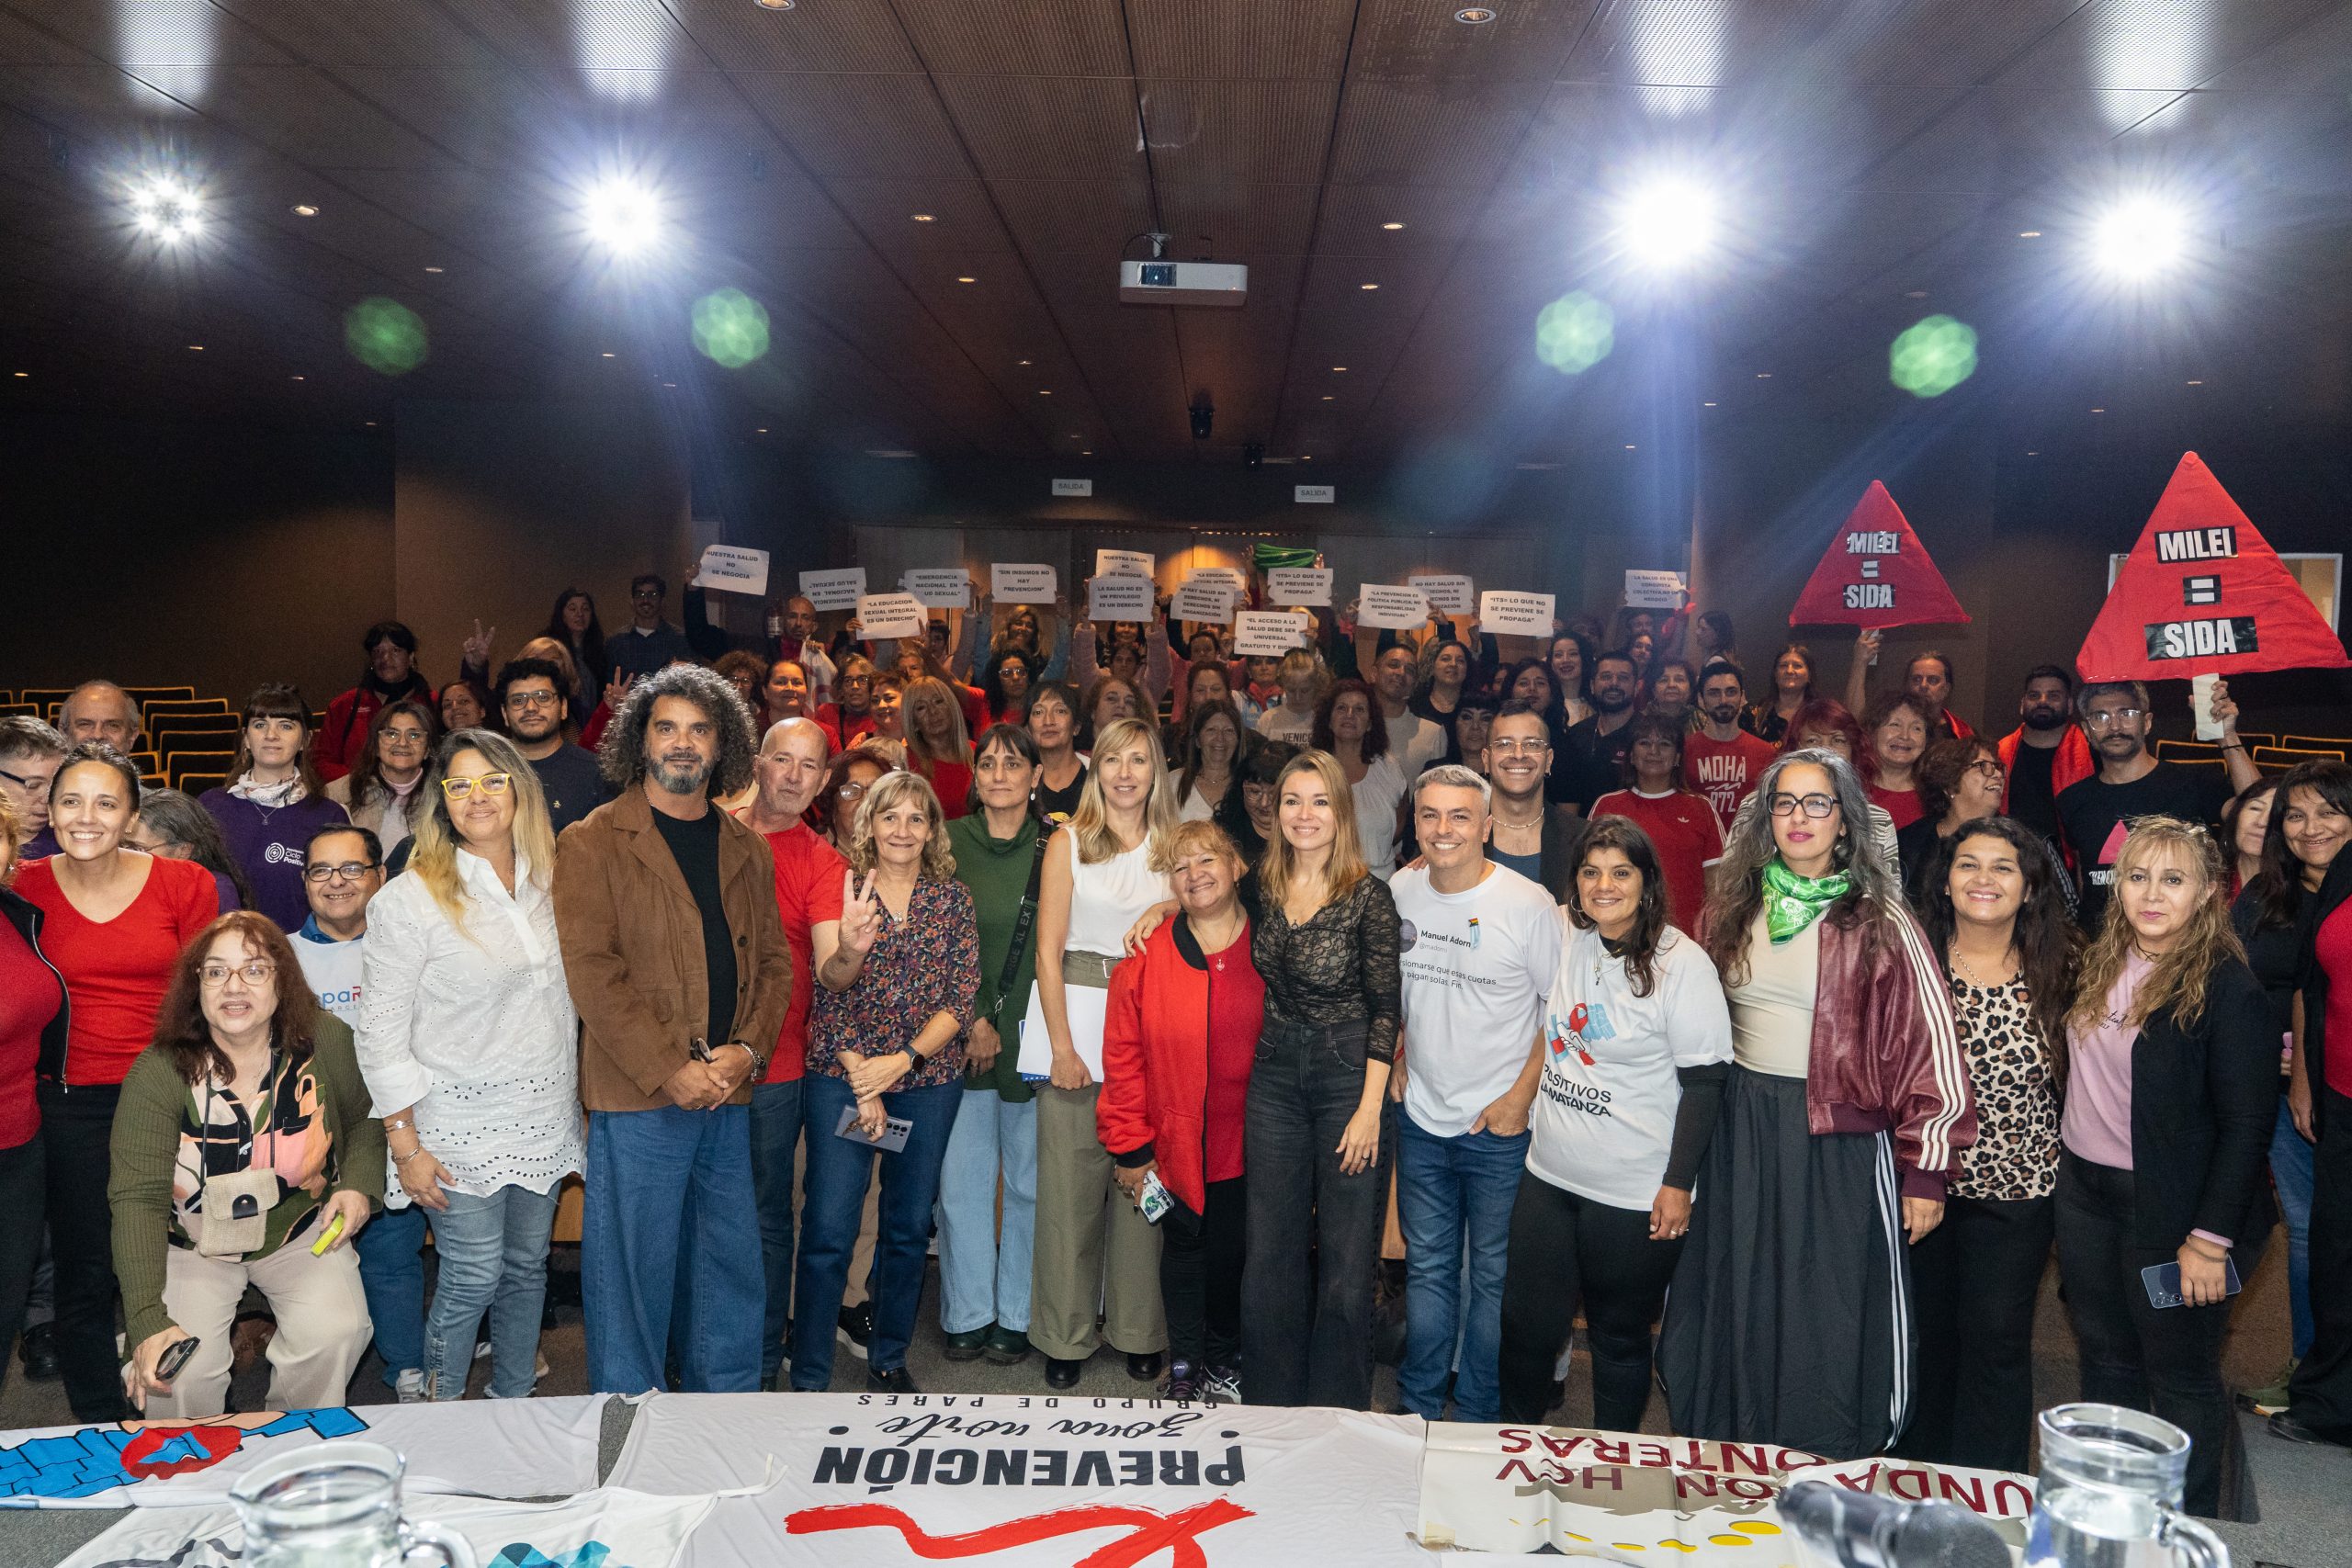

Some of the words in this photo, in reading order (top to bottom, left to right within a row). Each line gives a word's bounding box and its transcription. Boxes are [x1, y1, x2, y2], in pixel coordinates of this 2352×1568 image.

[1849, 532, 1899, 554] MILEI
[2159, 528, 2233, 561] MILEI
[707, 551, 735, 559] NUESTRA
[721, 570, 751, 580] NEGOCIA
[1846, 584, 1894, 608] SIDA
[2164, 619, 2237, 658] SIDA
[285, 851, 301, 860] Ciclo
[1420, 930, 1448, 942] Manuel
[1449, 935, 1471, 948] Adorn
[1436, 964, 1450, 975] que
[1451, 970, 1466, 980] esas
[1467, 975, 1497, 985] cuotas
[858, 1394, 984, 1408] PARES
[1017, 1396, 1059, 1408] DE
[1093, 1397, 1217, 1409] GRUPO
[876, 1412, 1031, 1447] norte
[1047, 1412, 1204, 1438] zona
[1498, 1428, 1827, 1476] ONTERAS
[812, 1446, 1246, 1495] PREVENCIÓN
